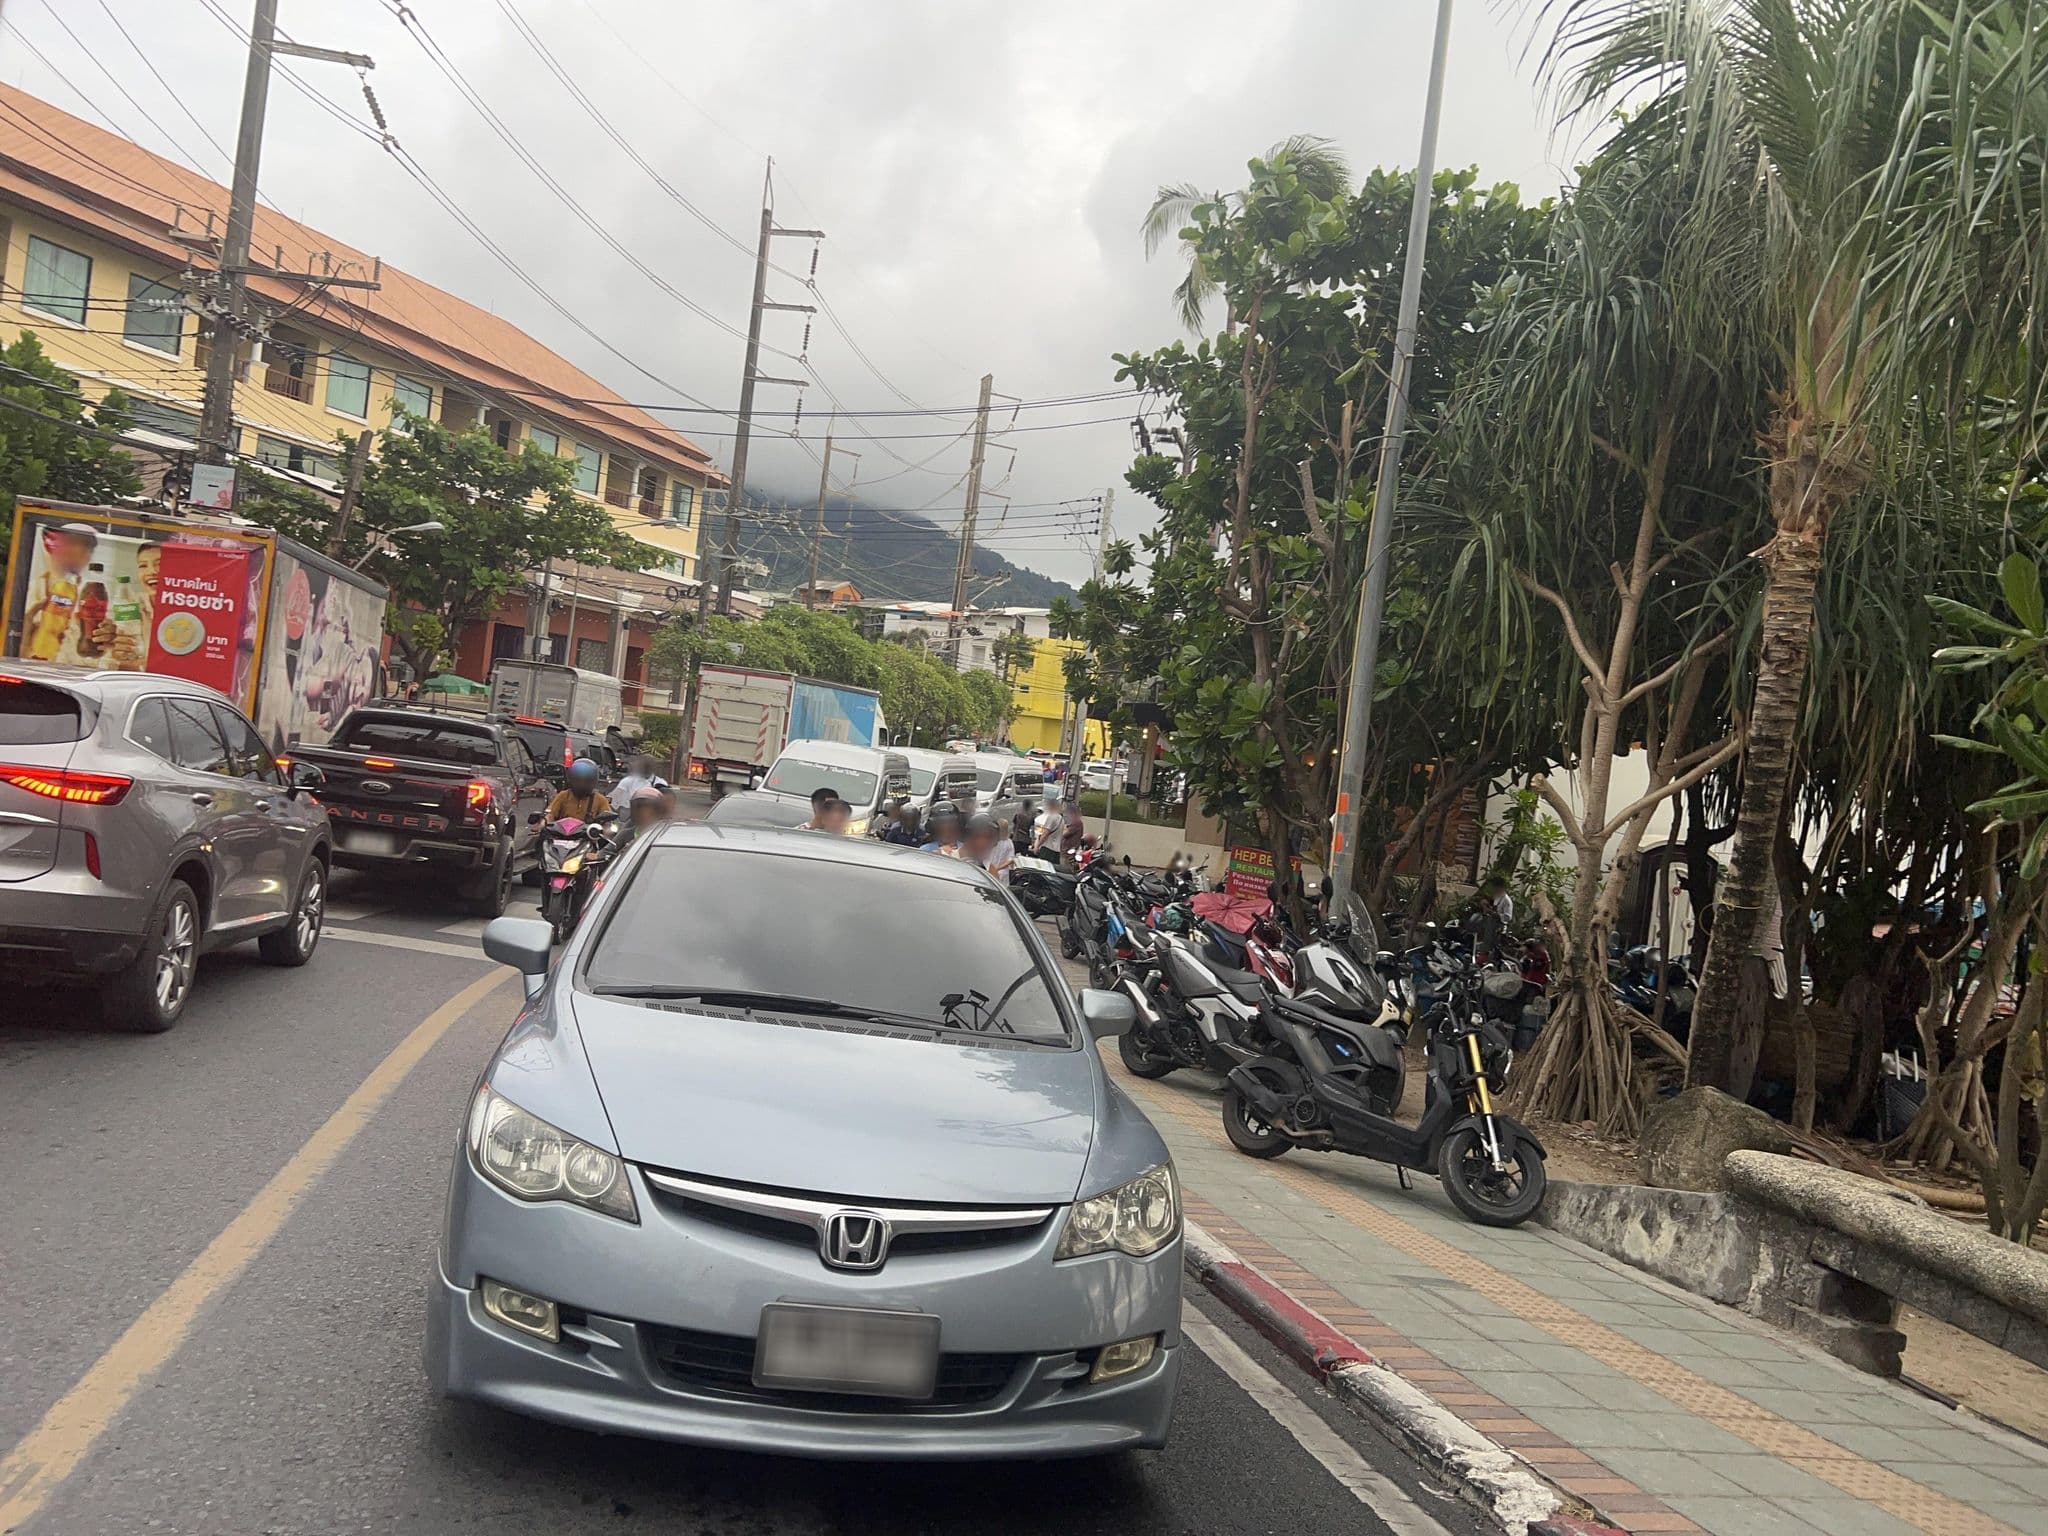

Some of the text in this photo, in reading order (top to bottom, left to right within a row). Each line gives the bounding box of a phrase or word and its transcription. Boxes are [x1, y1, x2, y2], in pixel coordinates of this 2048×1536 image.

[164, 577, 217, 592] ขนาดใหม่
[161, 591, 234, 612] หรอยซ่า
[207, 635, 228, 645] บาท
[326, 807, 446, 832] ANGER
